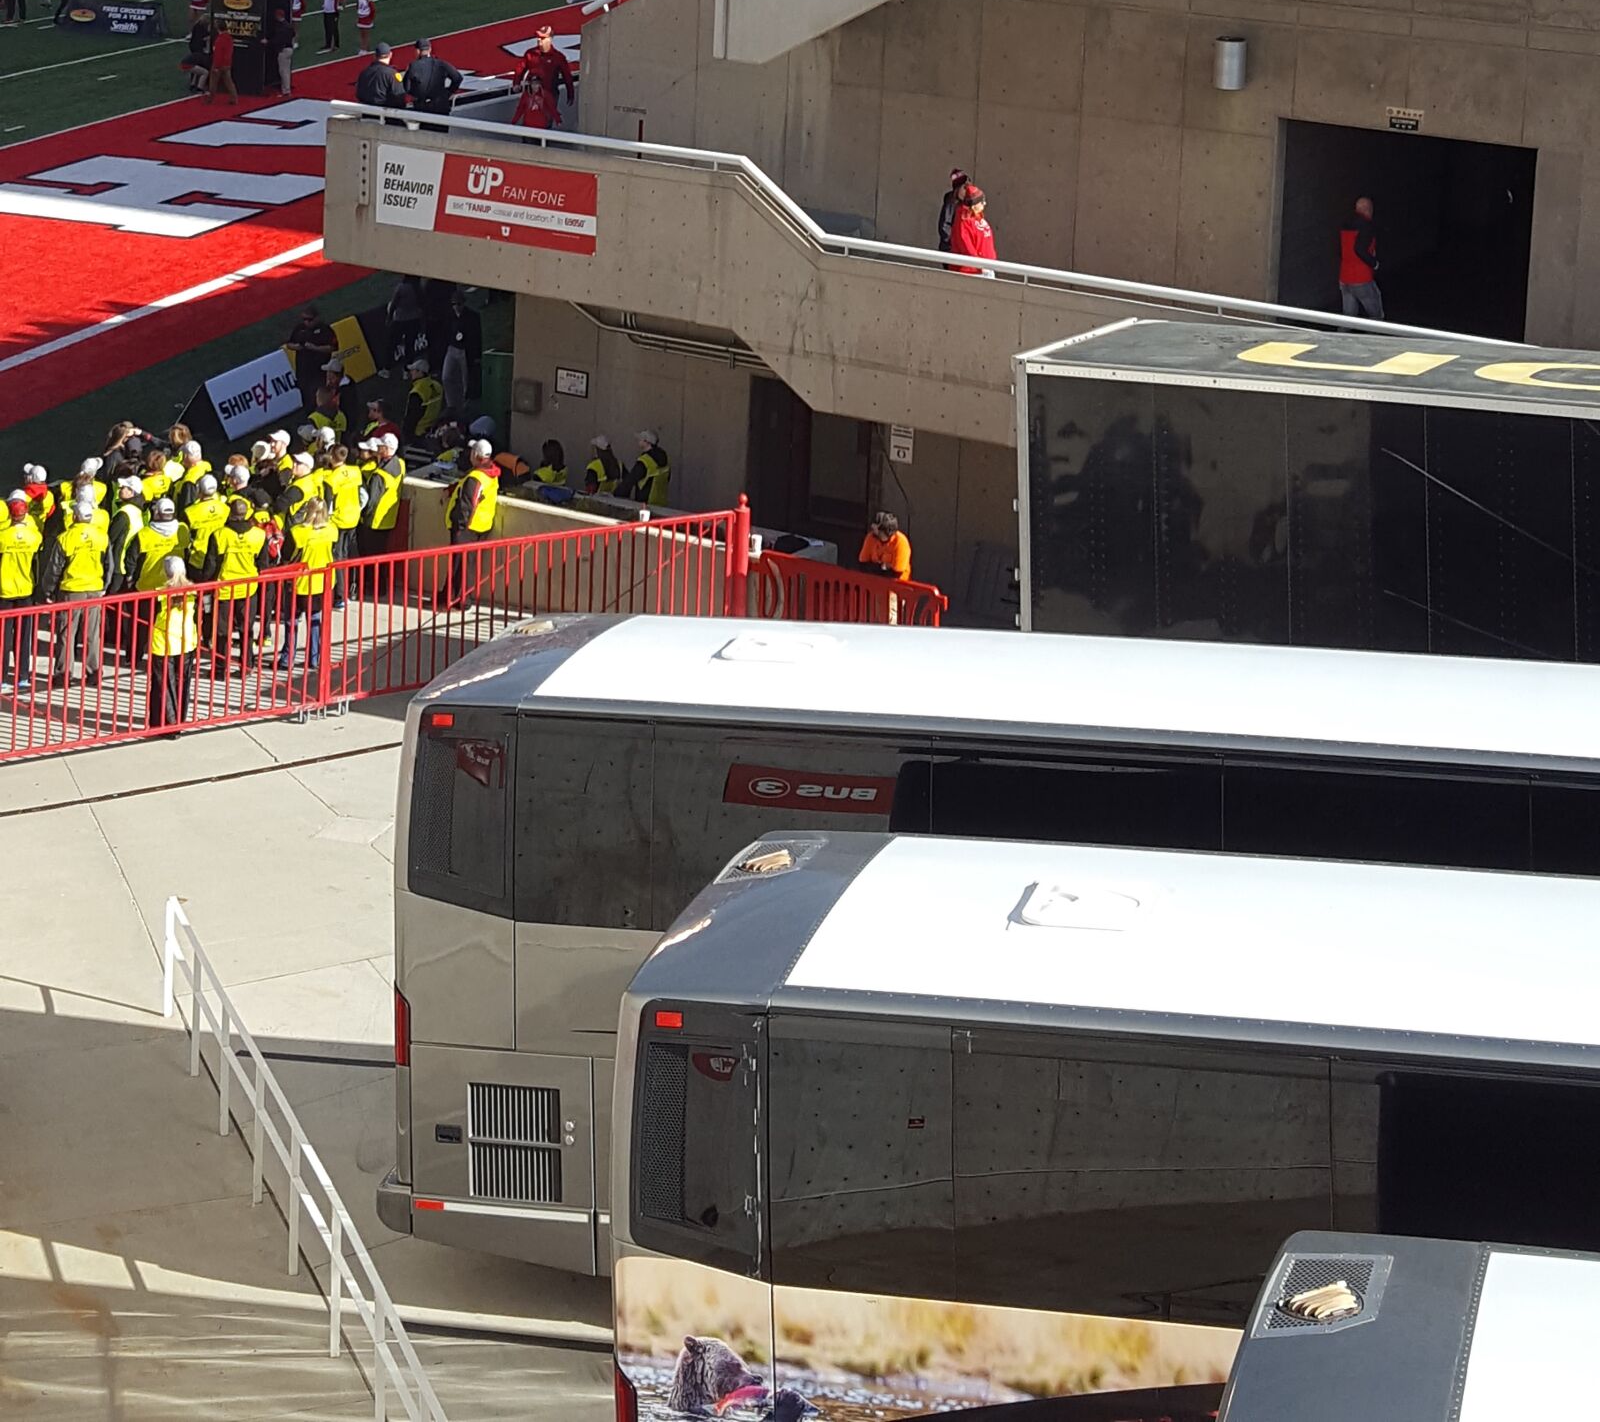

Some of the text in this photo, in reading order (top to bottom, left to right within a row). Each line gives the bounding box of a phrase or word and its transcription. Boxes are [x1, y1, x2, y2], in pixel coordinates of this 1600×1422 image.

[102, 5, 119, 13] FREE
[383, 162, 405, 176] FAN
[383, 178, 434, 196] BEHAVIOR
[467, 166, 504, 195] UP
[383, 193, 418, 209] ISSUE?
[502, 185, 567, 207] FAN FONE
